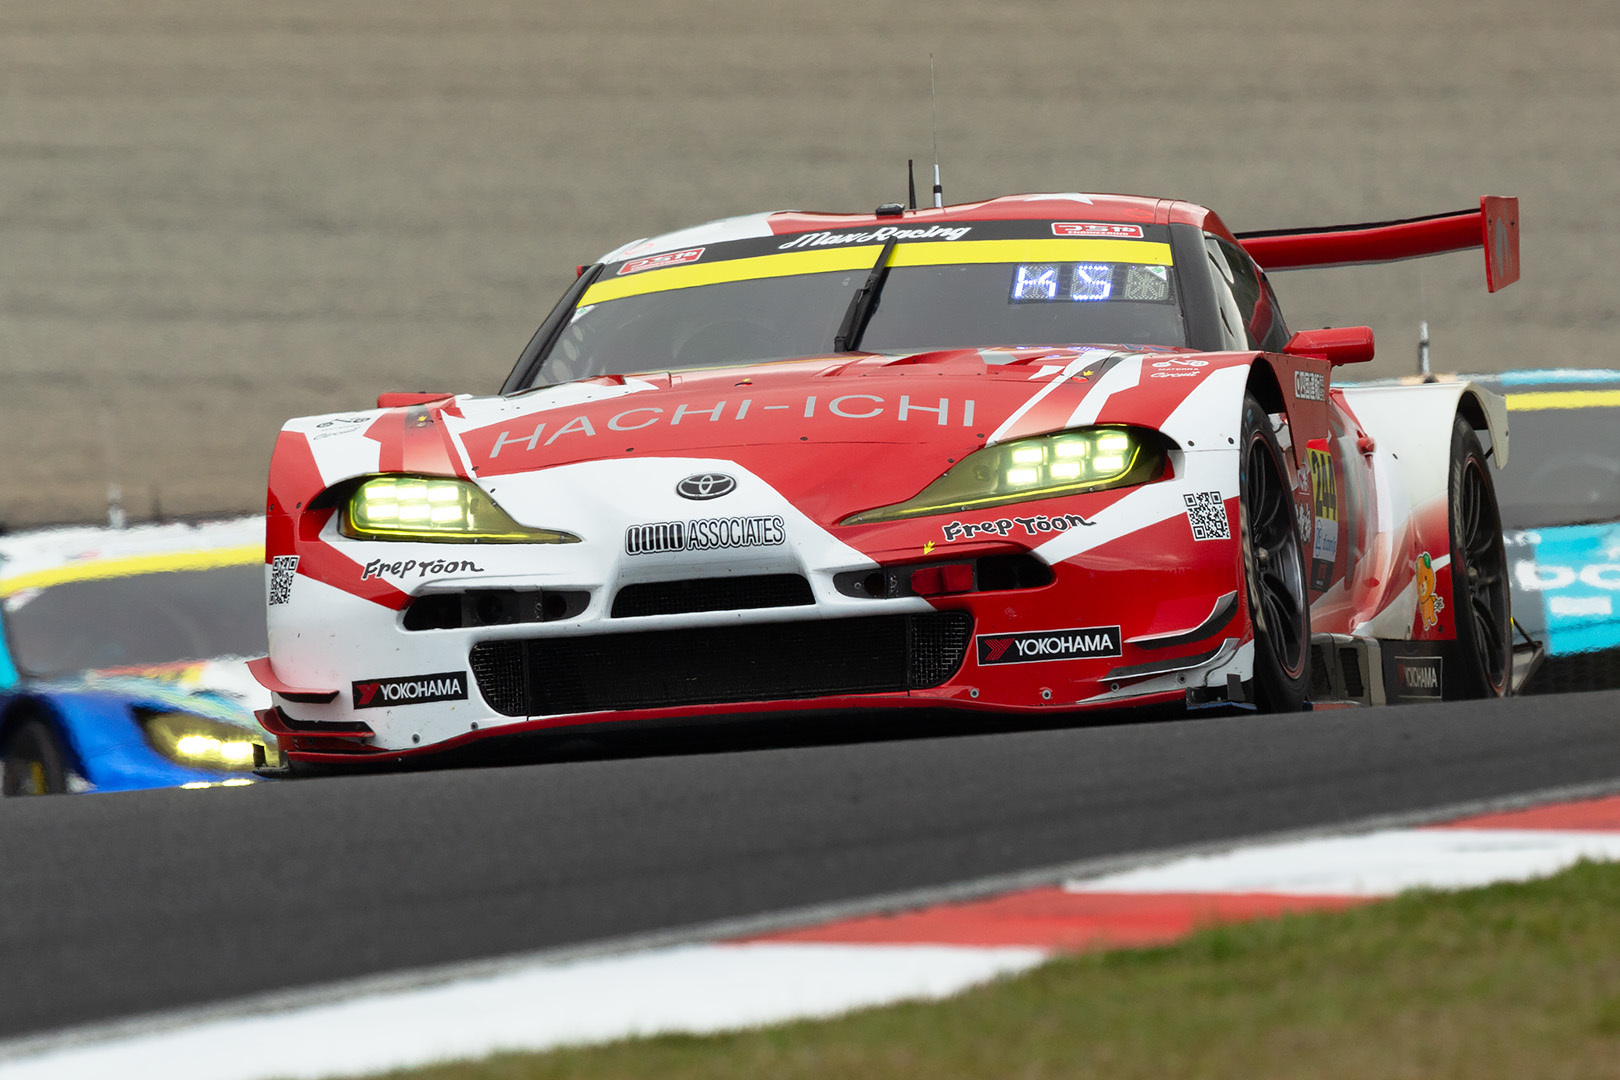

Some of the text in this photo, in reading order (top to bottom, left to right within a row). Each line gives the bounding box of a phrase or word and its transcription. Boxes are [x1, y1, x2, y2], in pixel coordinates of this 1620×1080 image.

[489, 395, 976, 459] HACHI-ICHI
[687, 517, 783, 550] ASSOCIATES
[1015, 633, 1113, 656] YOKOHAMA
[380, 679, 461, 700] YOKOHAMA
